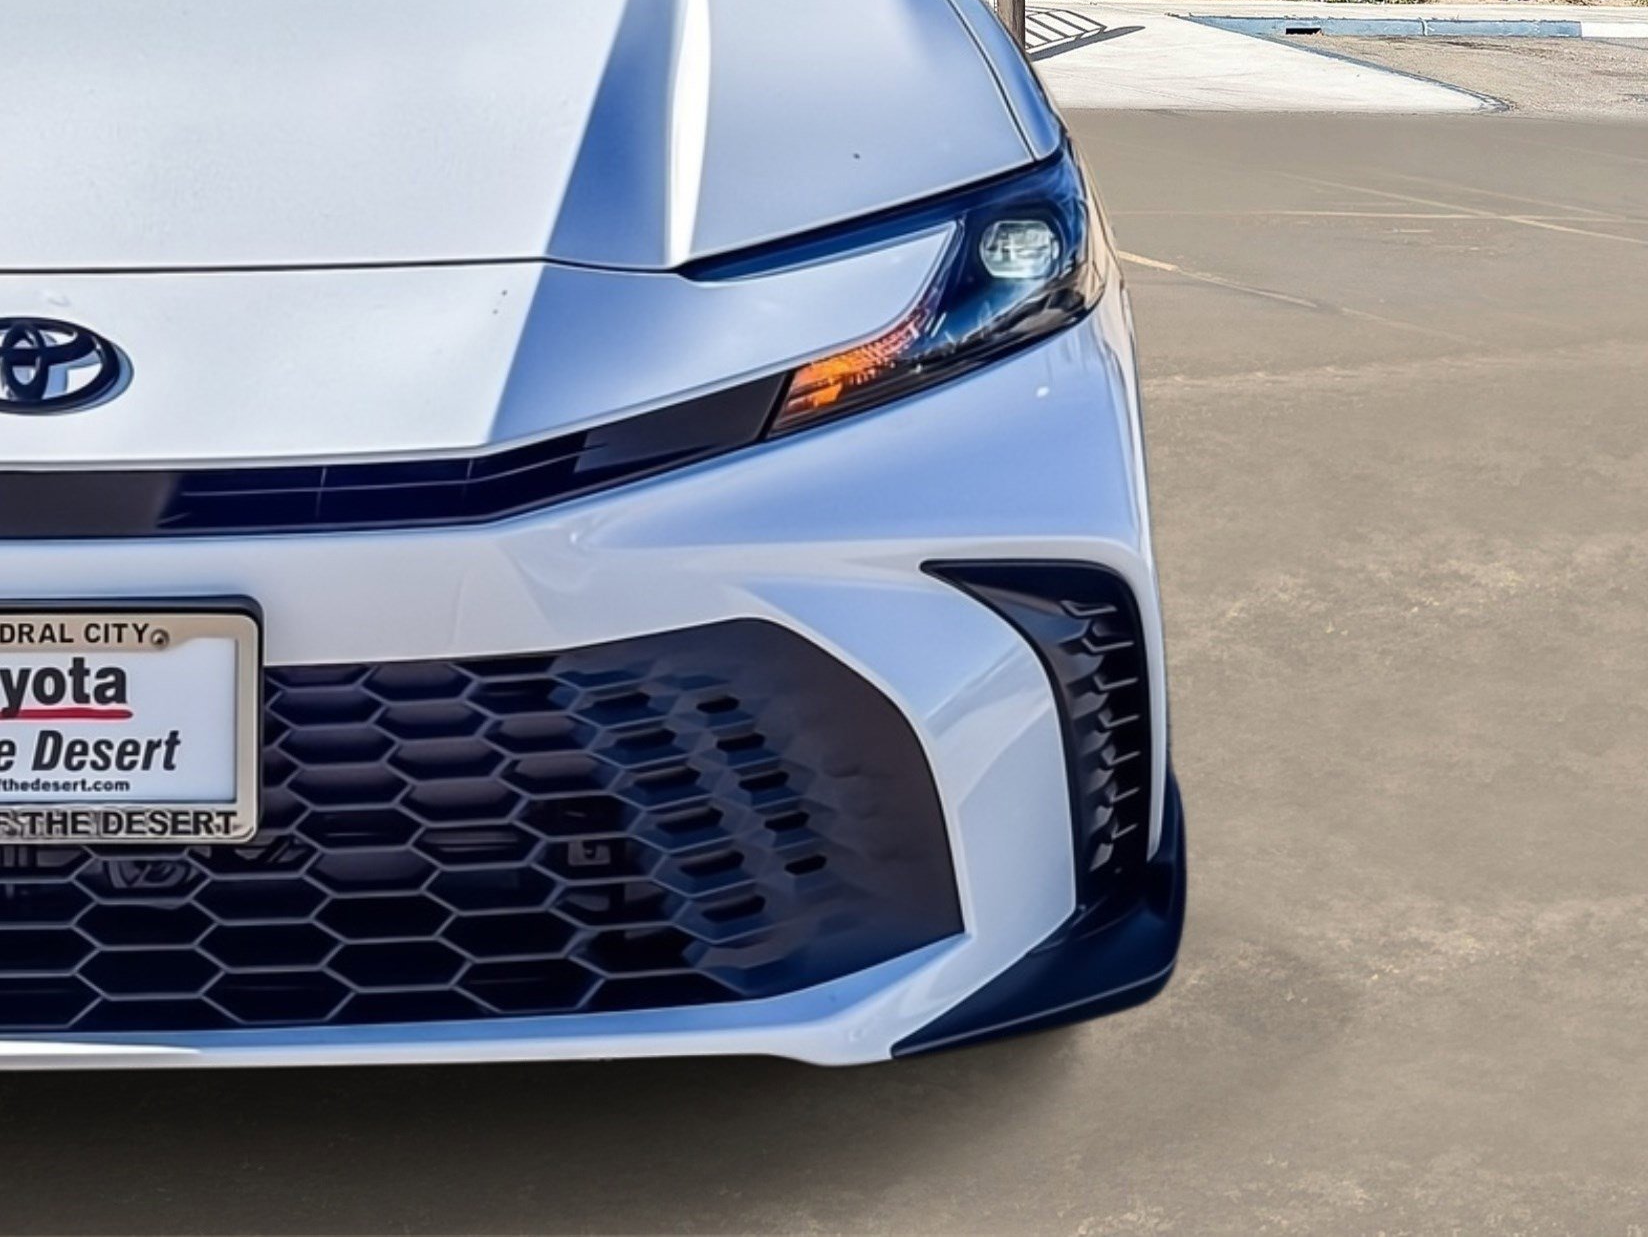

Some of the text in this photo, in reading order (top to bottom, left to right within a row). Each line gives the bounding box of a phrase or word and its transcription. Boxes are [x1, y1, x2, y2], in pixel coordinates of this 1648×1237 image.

[83, 622, 150, 644] CITY
[30, 729, 182, 772] Desert
[16, 810, 94, 838] THE
[101, 809, 239, 837] DESERT
